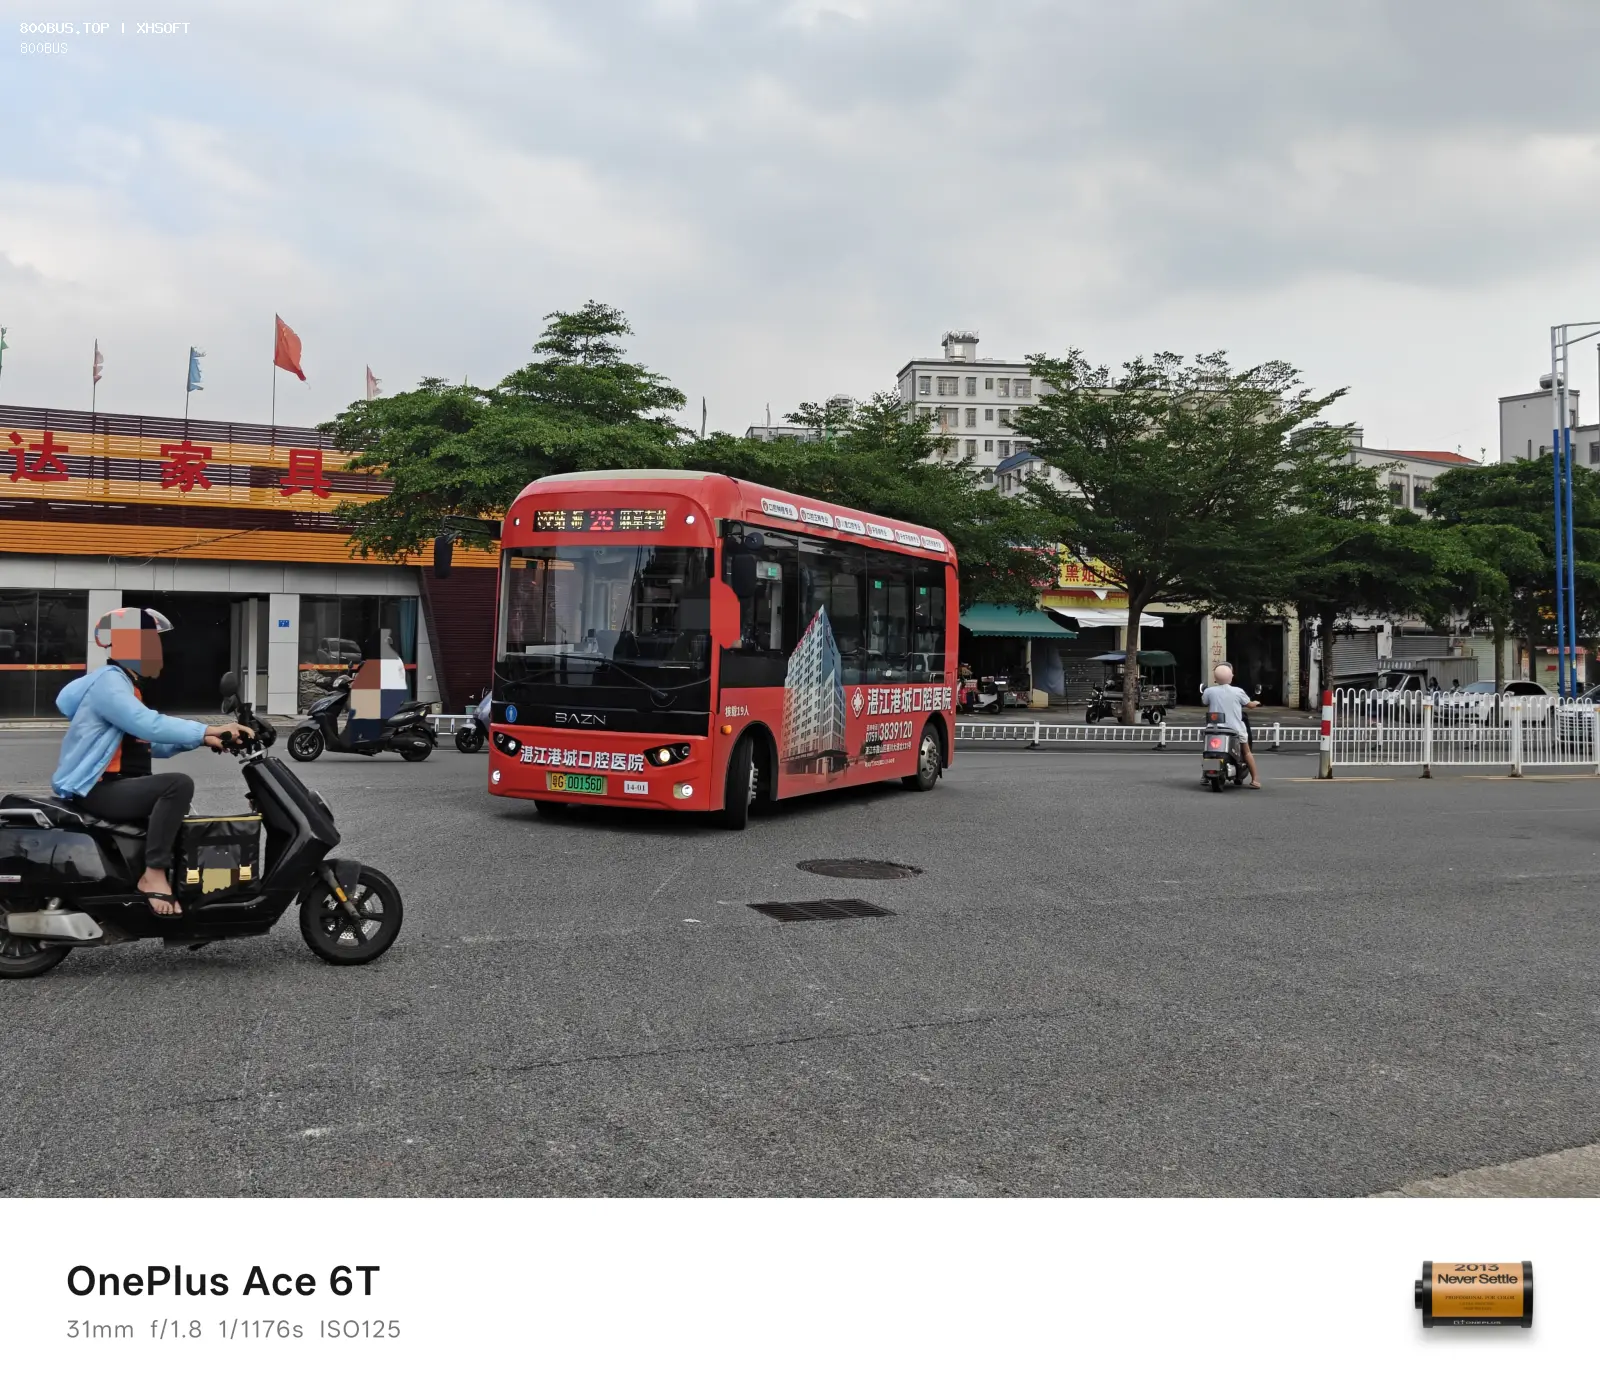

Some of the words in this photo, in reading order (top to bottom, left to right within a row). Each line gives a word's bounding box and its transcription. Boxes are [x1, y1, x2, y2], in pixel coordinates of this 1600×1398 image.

[867, 686, 952, 716] 湛江港城口腔医院
[554, 712, 606, 726] BAZN
[879, 720, 913, 741] 3839120
[519, 744, 645, 772] 湛江港城口腔医院
[626, 783, 646, 792] 14-01
